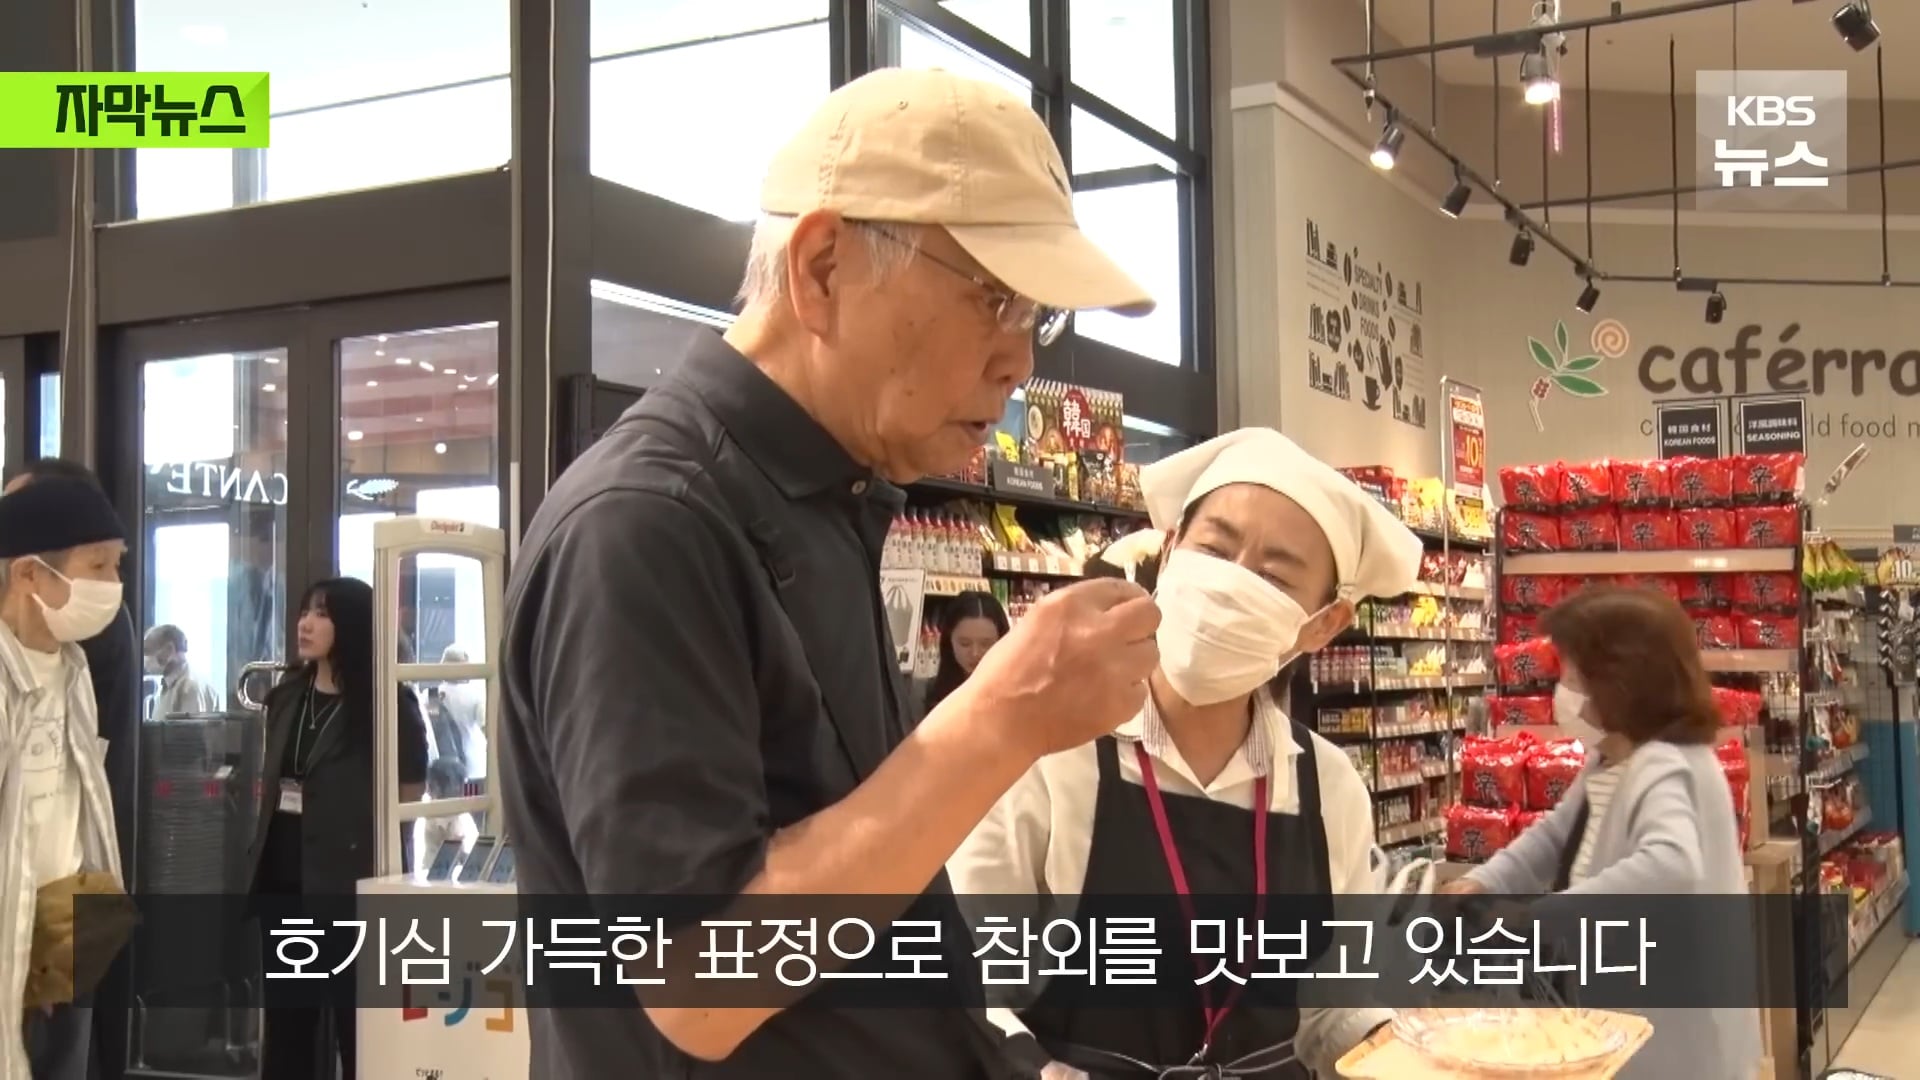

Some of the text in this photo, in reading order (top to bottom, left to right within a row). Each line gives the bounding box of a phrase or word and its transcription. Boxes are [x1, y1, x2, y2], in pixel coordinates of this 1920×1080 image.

[1663, 435, 1716, 447] KOREAN FOODS
[1746, 430, 1801, 443] SEASONING
